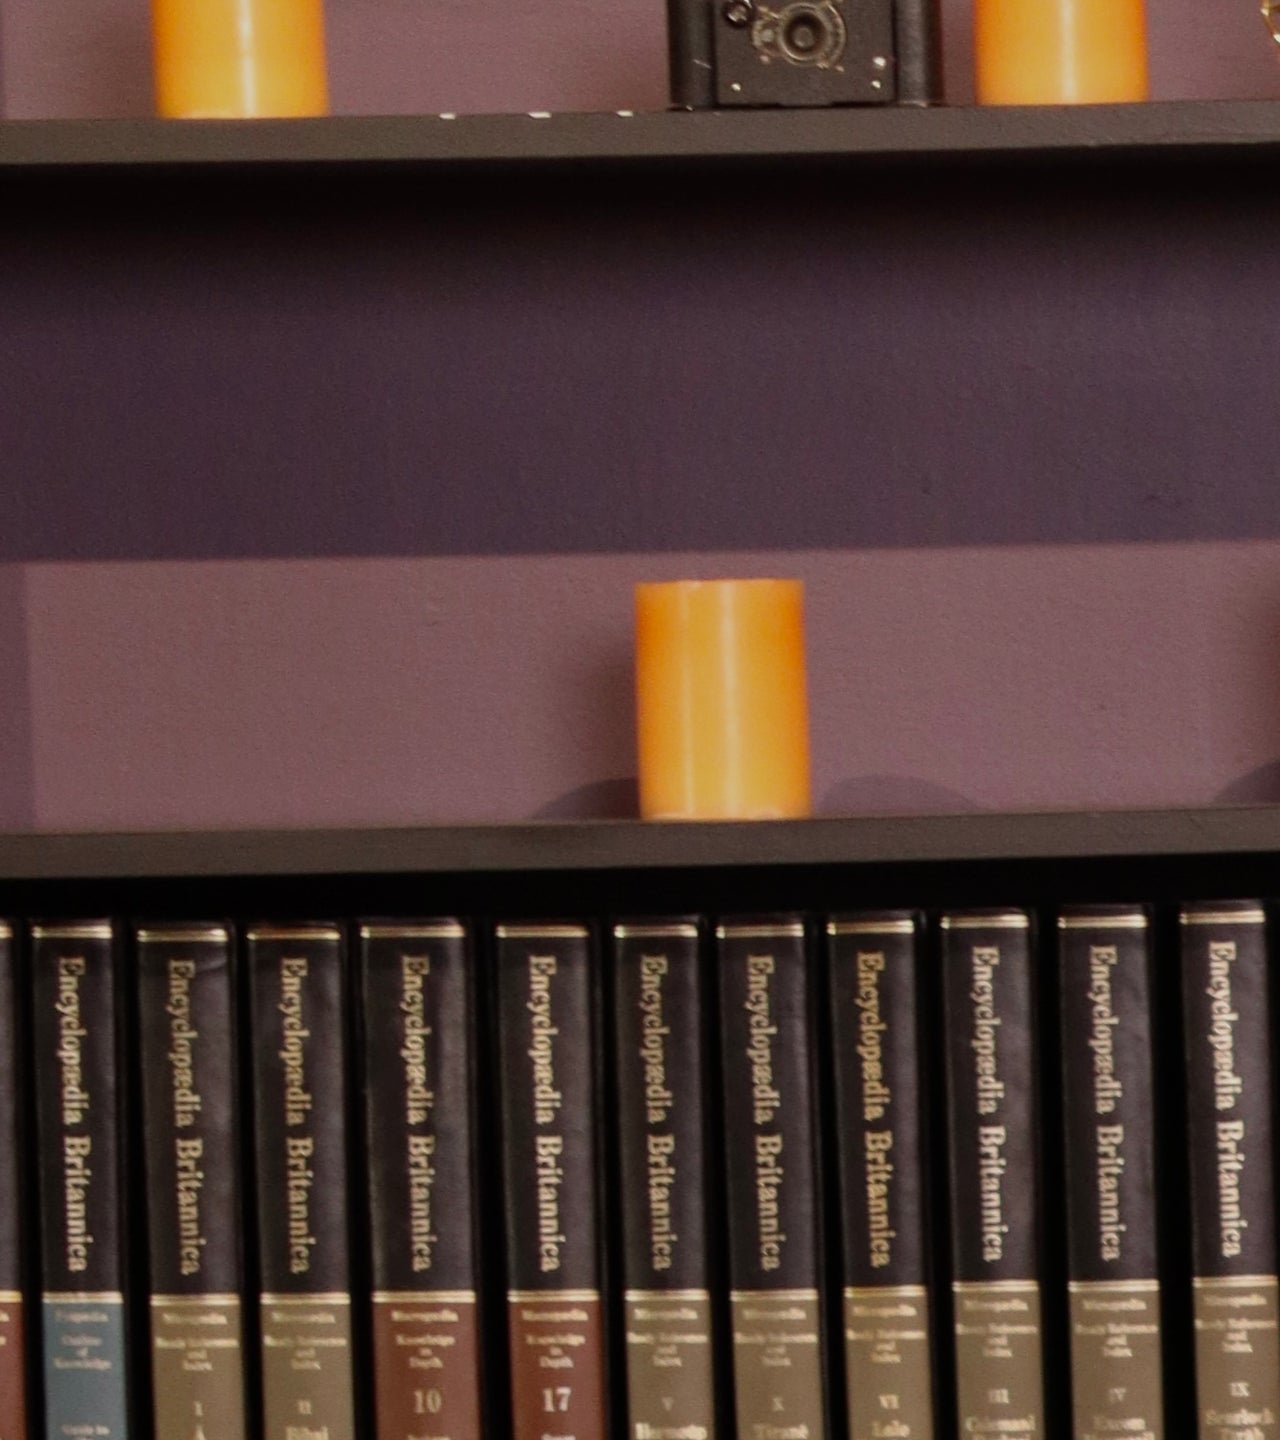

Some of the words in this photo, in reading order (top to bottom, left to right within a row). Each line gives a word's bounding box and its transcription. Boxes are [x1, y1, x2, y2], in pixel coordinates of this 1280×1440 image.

[64, 1136, 94, 1272] Britannica
[176, 1138, 207, 1275] Britannica
[287, 1137, 316, 1273] Britannica
[408, 1135, 437, 1272] Britannica
[536, 1136, 566, 1272] Britannica
[647, 1134, 678, 1270] Britannica
[755, 1134, 786, 1271] Britannica
[865, 1130, 896, 1268] Britannica
[980, 1125, 1009, 1261] Britannica
[1097, 1124, 1127, 1260] Britannica
[1217, 1120, 1248, 1258] Britannica
[414, 1388, 442, 1414] 10
[542, 1386, 572, 1413] 17
